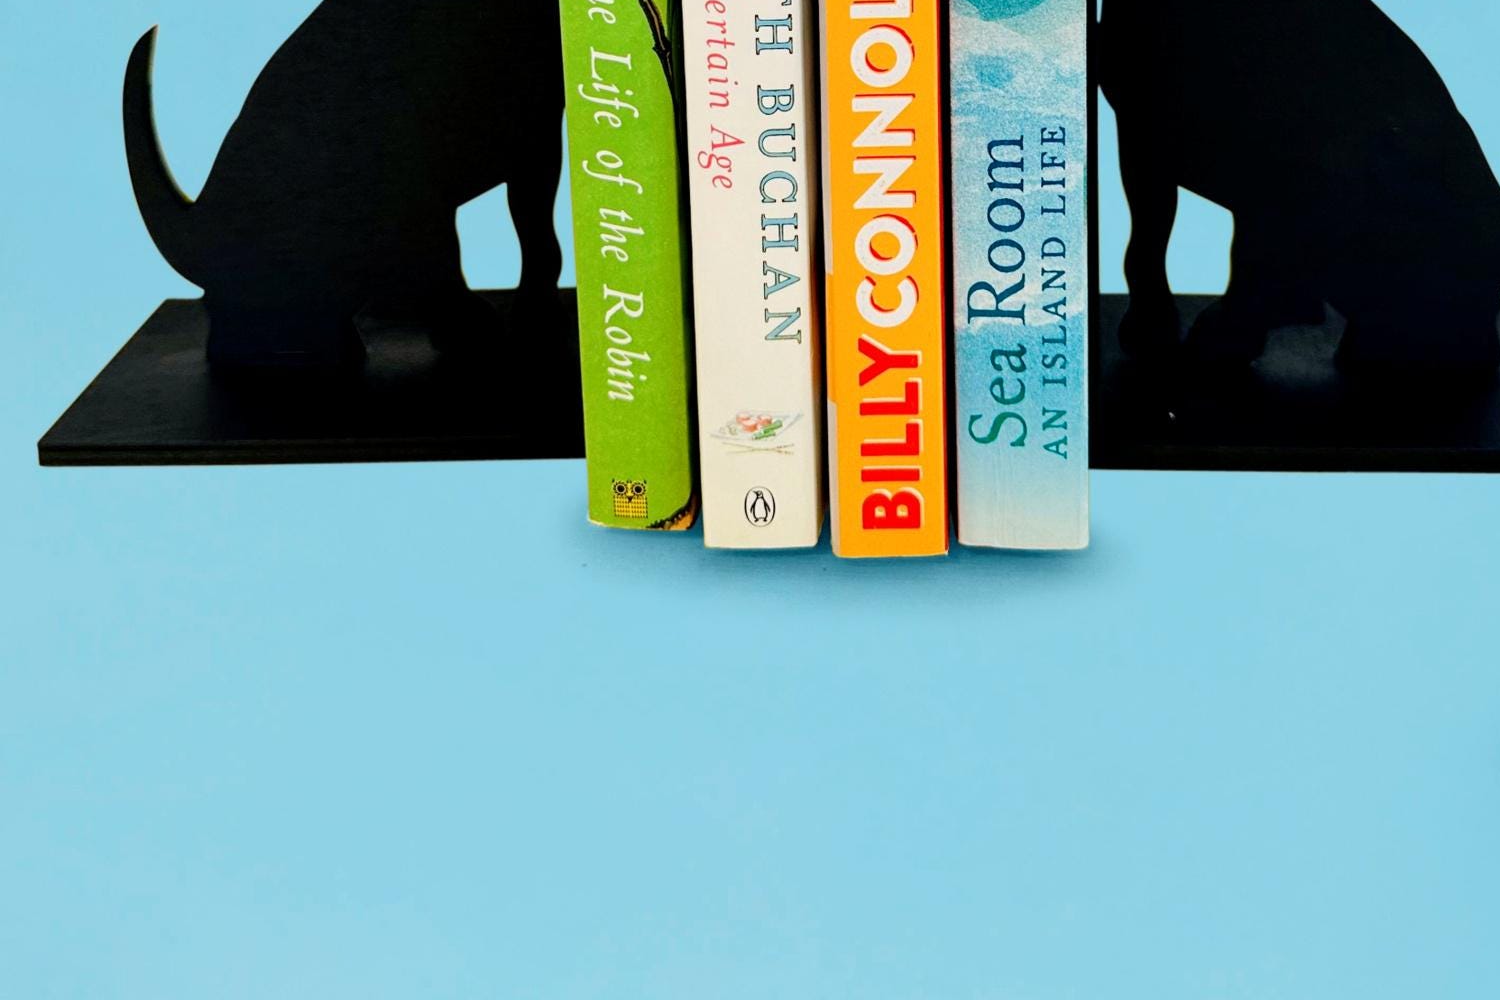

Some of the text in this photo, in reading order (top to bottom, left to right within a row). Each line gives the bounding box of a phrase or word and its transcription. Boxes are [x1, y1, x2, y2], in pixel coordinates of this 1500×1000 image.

[578, 46, 639, 129] Life
[581, 149, 642, 194] of
[698, 124, 745, 190] Age
[597, 203, 646, 264] the
[755, 84, 802, 344] BUCHAN
[966, 135, 1027, 447] Sea Room
[1040, 124, 1069, 459] AN ISLAND LIFE
[602, 283, 652, 403] Robin
